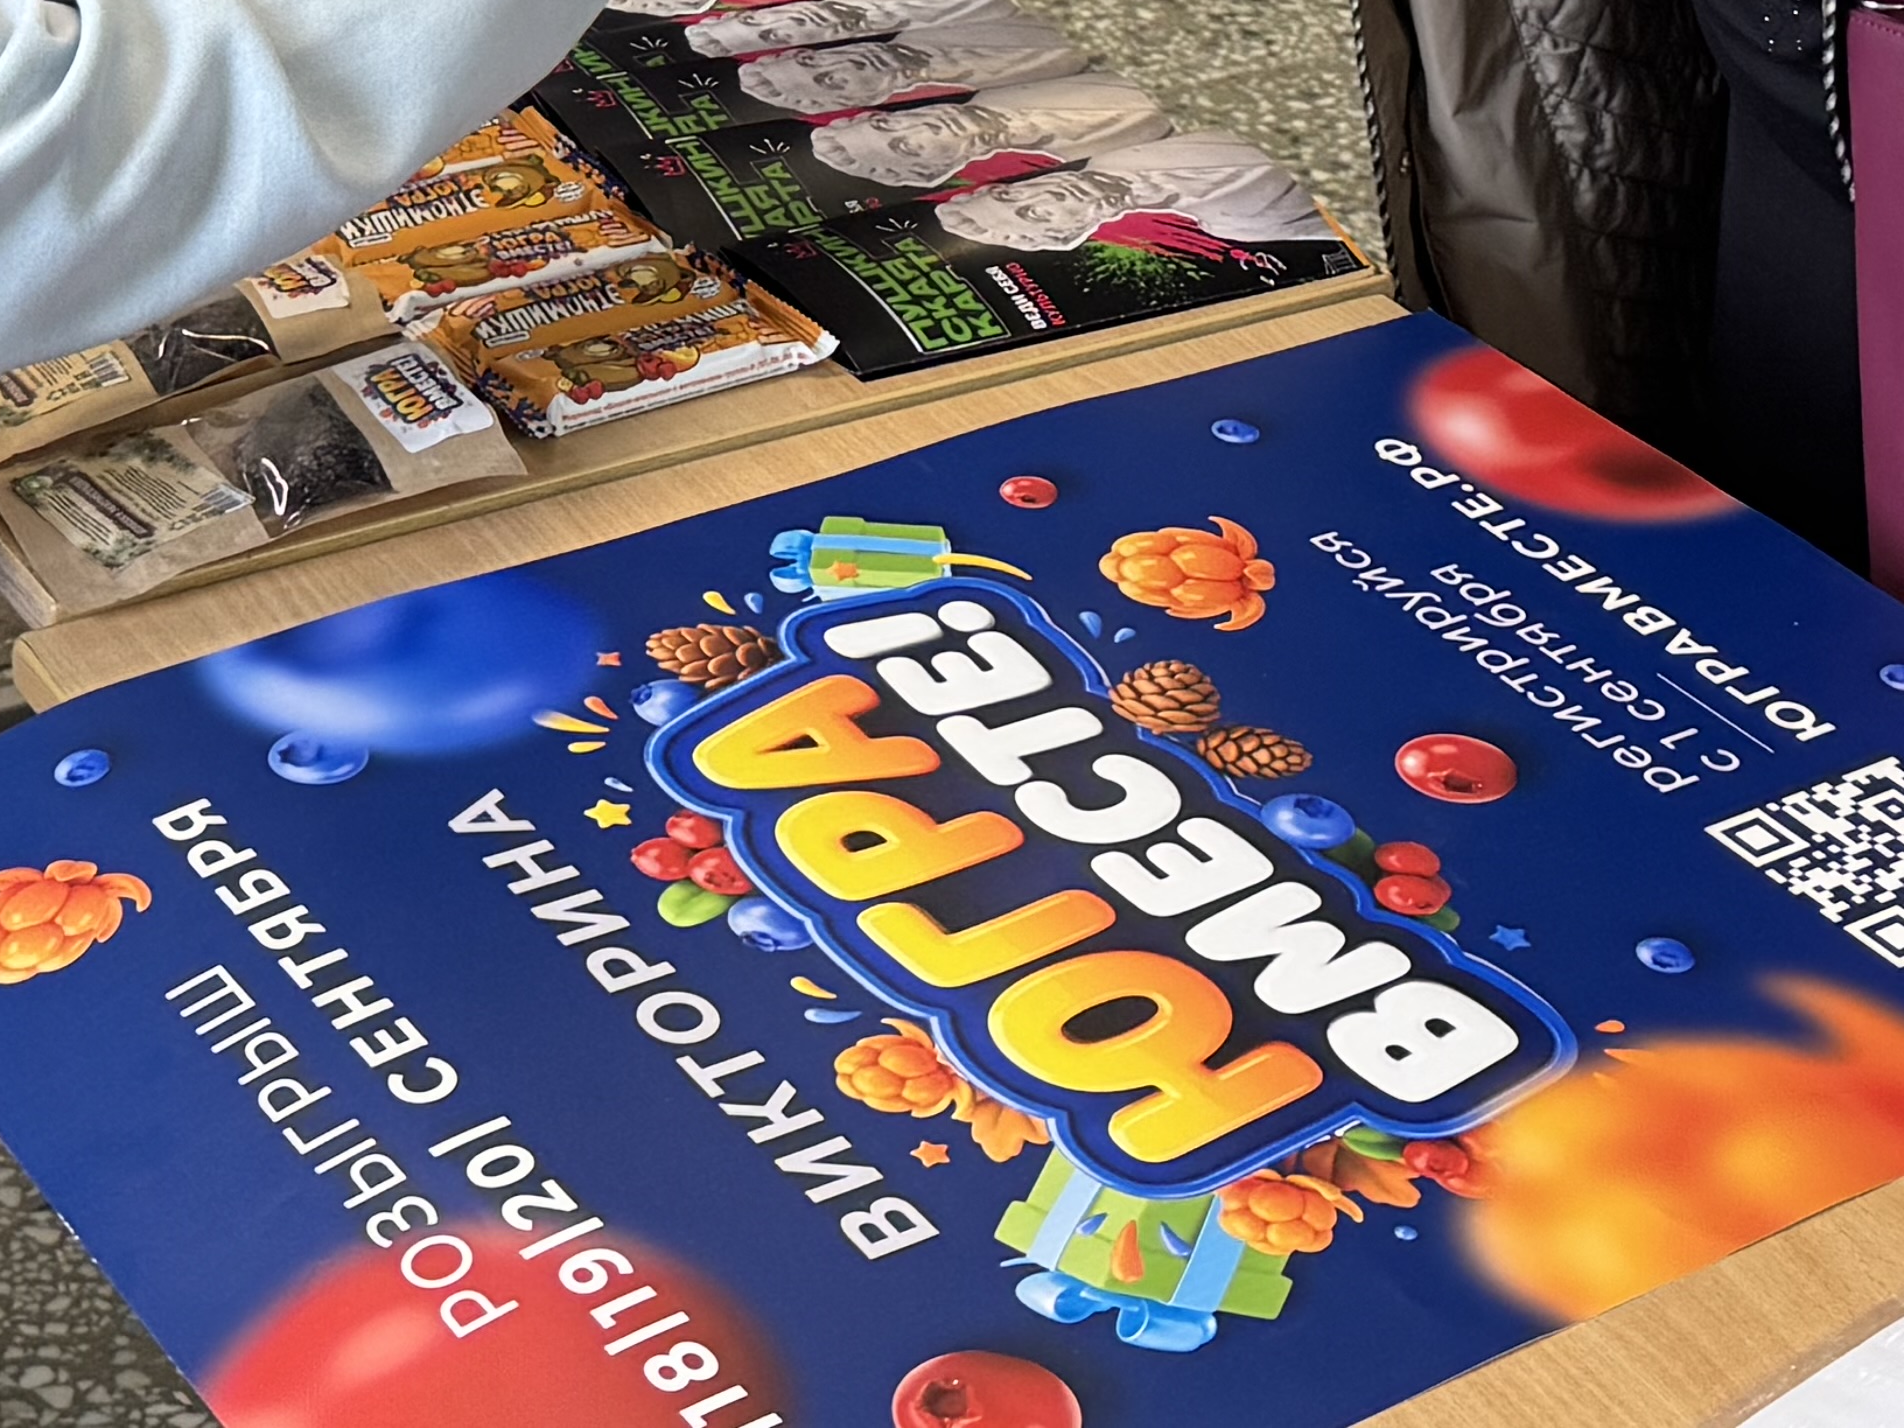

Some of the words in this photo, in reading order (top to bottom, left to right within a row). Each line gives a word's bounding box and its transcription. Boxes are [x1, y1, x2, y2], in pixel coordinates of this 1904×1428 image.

[340, 188, 491, 241] ЭТНОМИШКИ
[675, 141, 766, 239] ШКИН
[745, 184, 791, 229] АЯ
[761, 160, 824, 228] РТА
[475, 283, 626, 337] ЭТНОМИШКИ
[801, 228, 950, 351] ПУШКИН
[879, 256, 973, 342] СКАЯ
[894, 236, 1005, 339] КАРТА
[985, 265, 1020, 295] СЕБЯ
[1005, 261, 1067, 328] КУЛЬТУРНО
[1010, 294, 1048, 331] ВЕДИ
[370, 368, 435, 423] ЮГРА
[390, 355, 459, 411] ВМЕСТЕ!
[1374, 437, 1837, 743] ЮГРАВМЕСТЕ.РФ
[1309, 531, 1701, 794] регистрируйся
[1429, 563, 1667, 722] сентября
[1659, 727, 1699, 750] 1
[823, 599, 1520, 1104] ВМЕСТЕ!
[151, 797, 459, 1106] СЕНТЯБРЯ
[692, 673, 1325, 1164] ЮГРА
[448, 788, 940, 1261] ВИКТОРИНА
[163, 963, 520, 1339] РОЗЫГРЫШ
